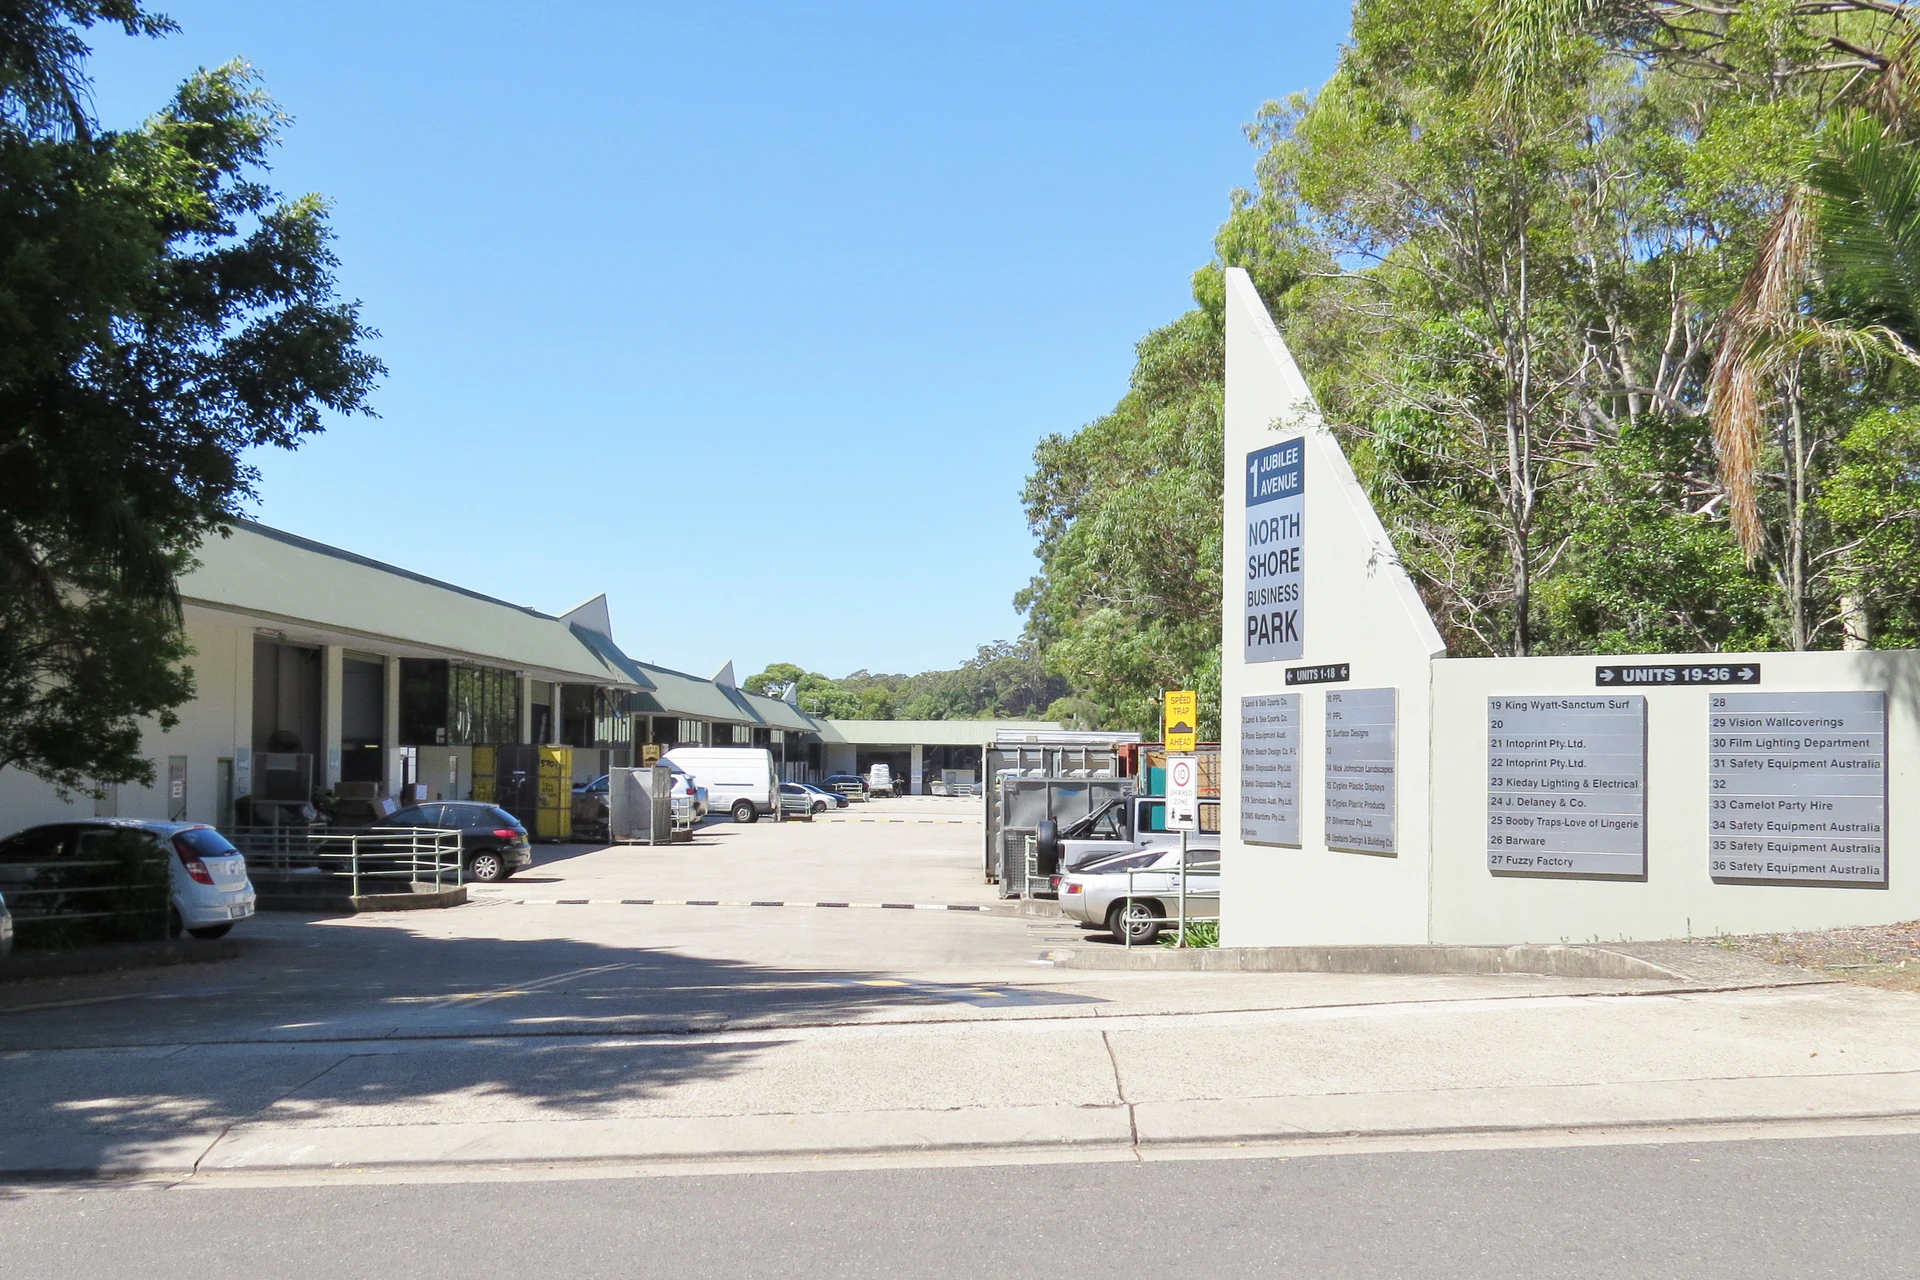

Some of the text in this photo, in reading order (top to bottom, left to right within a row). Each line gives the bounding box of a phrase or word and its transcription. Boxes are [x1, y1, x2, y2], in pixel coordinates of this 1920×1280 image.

[1250, 447, 1298, 497] 1 JUBILEE
[1260, 472, 1298, 496] AVENUE
[1249, 512, 1300, 547] NORTH
[1248, 547, 1300, 580] SHORE
[1248, 583, 1299, 607] BUSINESS
[1248, 609, 1299, 647] PARK
[1296, 667, 1336, 682] UNITS 1-18
[1622, 667, 1730, 682] UNITS 19-36
[1170, 696, 1191, 705] SPEED
[1333, 694, 1342, 702] PPL
[1713, 698, 1725, 707] 28
[1173, 707, 1190, 715] TRAP
[1491, 700, 1630, 711] 19 King Wyatt-Sanctum Surf
[1333, 711, 1342, 720] PPL
[1491, 720, 1503, 729] 20
[1713, 718, 1844, 729] 29 Vision Wallcoverings
[1333, 729, 1349, 737] Surface
[1351, 728, 1369, 739] Designs
[1170, 738, 1191, 746] AHEAD
[1491, 739, 1586, 750] 21 Intoprint Pty.Ltd.
[1713, 738, 1870, 750] 30 Film Lighting Department
[1268, 747, 1281, 757] Design
[1333, 764, 1343, 772] Nick
[1365, 764, 1394, 775] Landscapes
[1491, 758, 1587, 770] 22 Intoprint Pty.Ltd.
[1713, 759, 1881, 770] 31 Safety Equipment Australia
[1177, 769, 1186, 779] 10
[1348, 782, 1364, 790] Plastic
[1365, 782, 1385, 793] Displays
[1491, 778, 1503, 787] 23
[1541, 778, 1579, 789] Lighting
[1582, 780, 1590, 788] &
[1593, 779, 1639, 788] Electrical
[1713, 780, 1726, 789] 32
[1348, 799, 1364, 808] Plastic
[1365, 800, 1385, 810] Products
[1491, 797, 1586, 808] 24 J. Delaney & Co.
[1713, 800, 1833, 812] 33 Camelot Party Hire
[1491, 816, 1638, 830] 25 Booby Traps-Love of Lingerie
[1713, 821, 1880, 834] 34 Safety Equipment Australia
[1349, 835, 1363, 846] Design
[1368, 836, 1385, 848] Building
[1491, 835, 1546, 846] 26 Barware
[1713, 841, 1881, 854] 35 Safety Equipment Australia
[1491, 855, 1573, 867] 27 Fuzzy Factory
[1713, 861, 1880, 875] 36 Safety Equipment Australia
